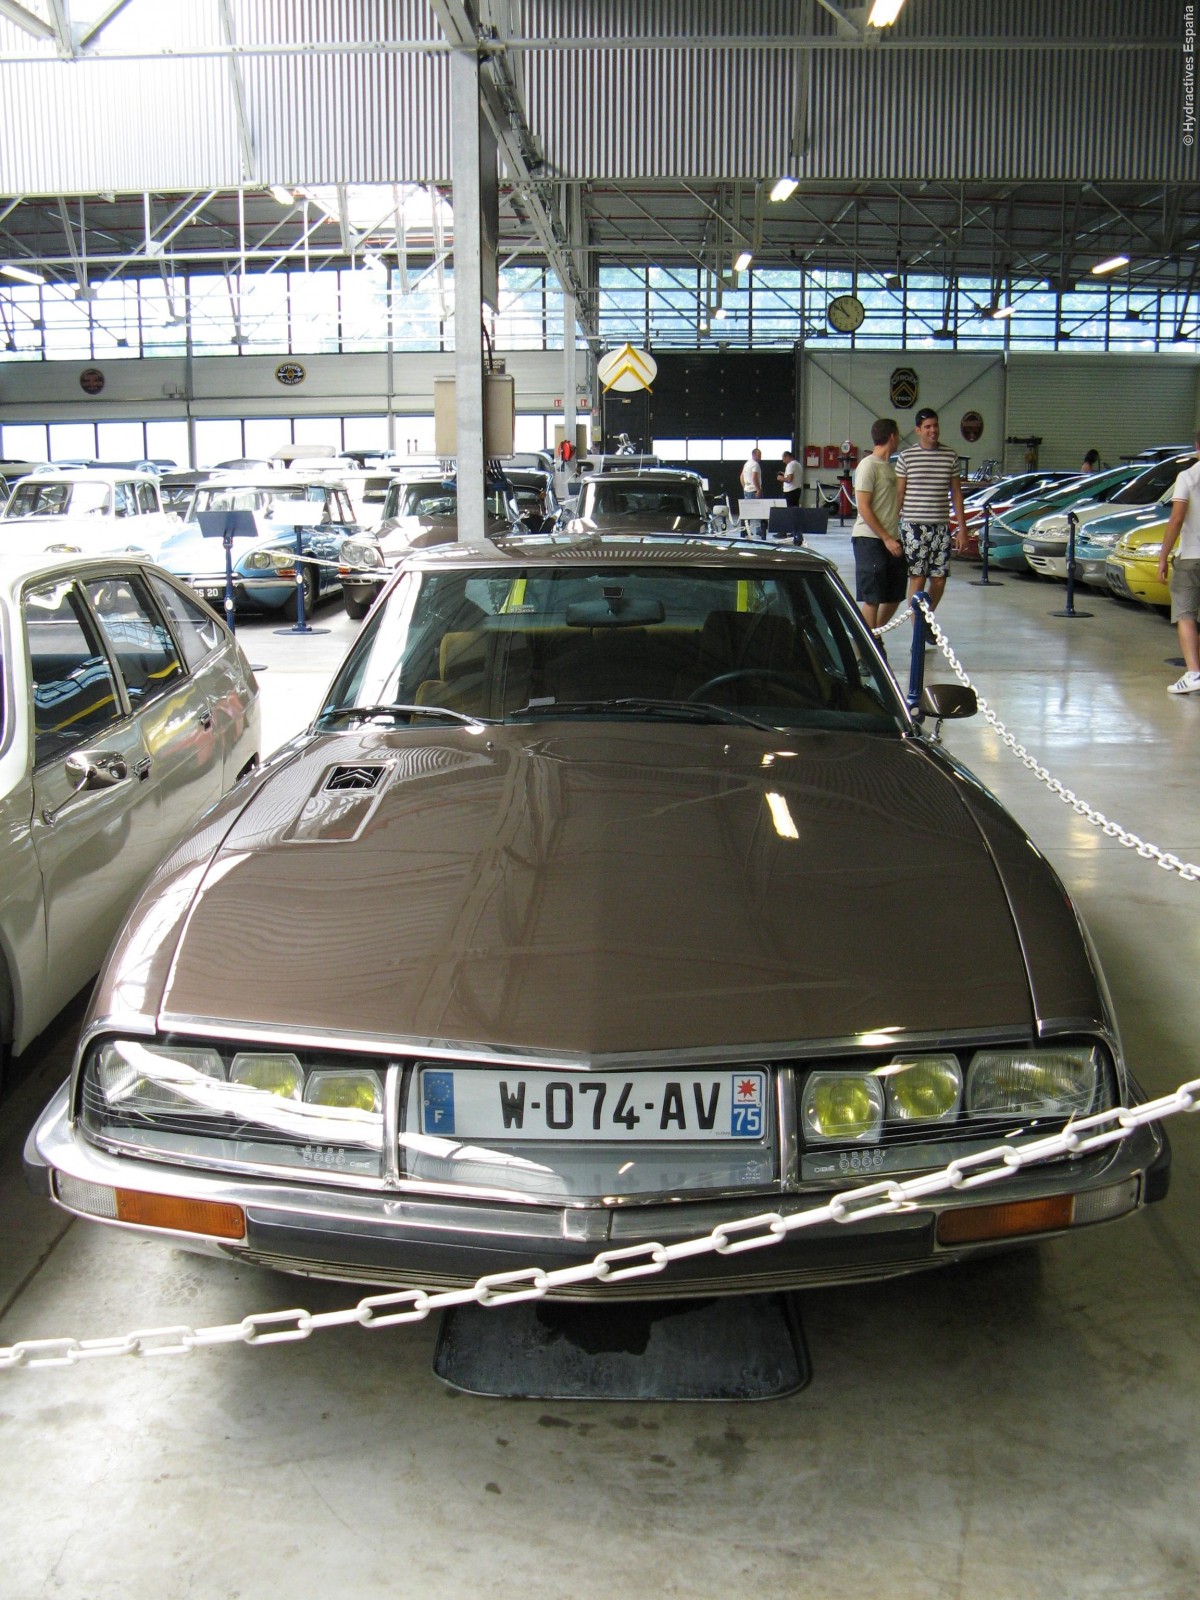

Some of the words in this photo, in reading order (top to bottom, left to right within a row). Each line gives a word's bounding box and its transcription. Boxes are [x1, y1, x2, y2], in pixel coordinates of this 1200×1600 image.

[206, 587, 219, 597] 20
[499, 1081, 721, 1130] W-074-AV
[433, 1110, 443, 1124] F
[733, 1108, 760, 1131] 75
